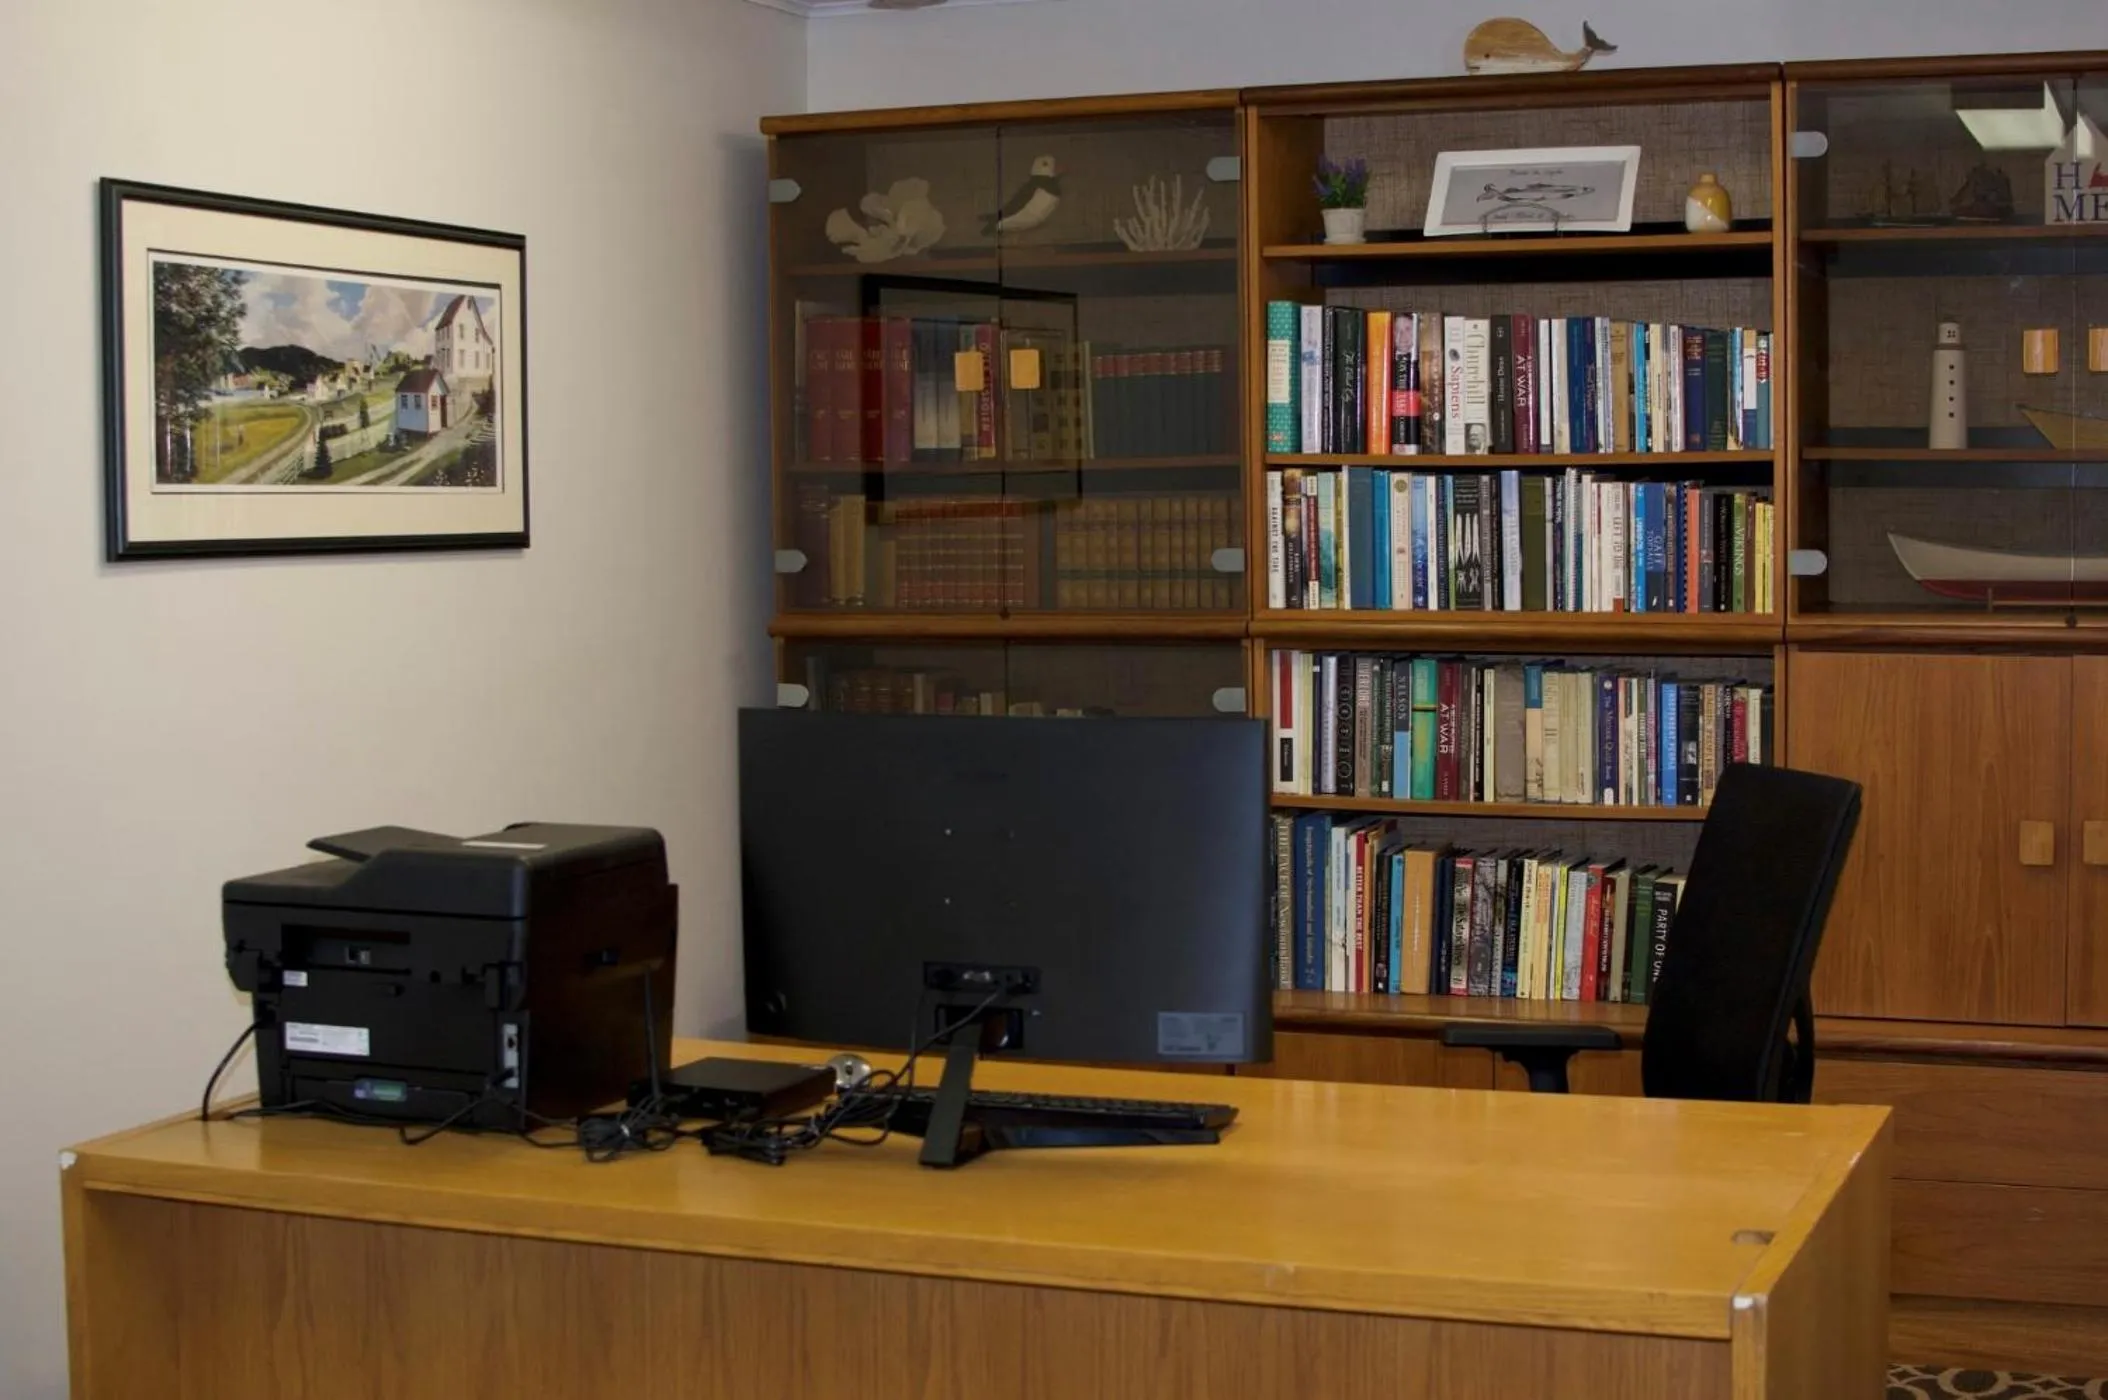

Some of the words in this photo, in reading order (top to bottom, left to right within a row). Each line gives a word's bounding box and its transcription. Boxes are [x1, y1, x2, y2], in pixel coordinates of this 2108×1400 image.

[1466, 333, 1485, 404] Churchill
[1516, 355, 1527, 372] AT
[1448, 366, 1462, 419] Sapiens
[1516, 375, 1527, 408] WAR
[1613, 517, 1623, 536] LEFT
[1613, 541, 1623, 552] TO
[1734, 527, 1745, 576] VIKINGS
[1357, 662, 1370, 708] OVERLORD
[1397, 675, 1407, 720] NELSON
[1439, 703, 1449, 719] AT
[1439, 723, 1449, 754] WAR
[1279, 825, 1291, 847] THE
[1279, 852, 1291, 883] FACE
[1279, 884, 1291, 899] OF
[1656, 908, 1668, 941] PARTY
[1279, 902, 1291, 985] Newfoundland
[1655, 943, 1666, 956] OF
